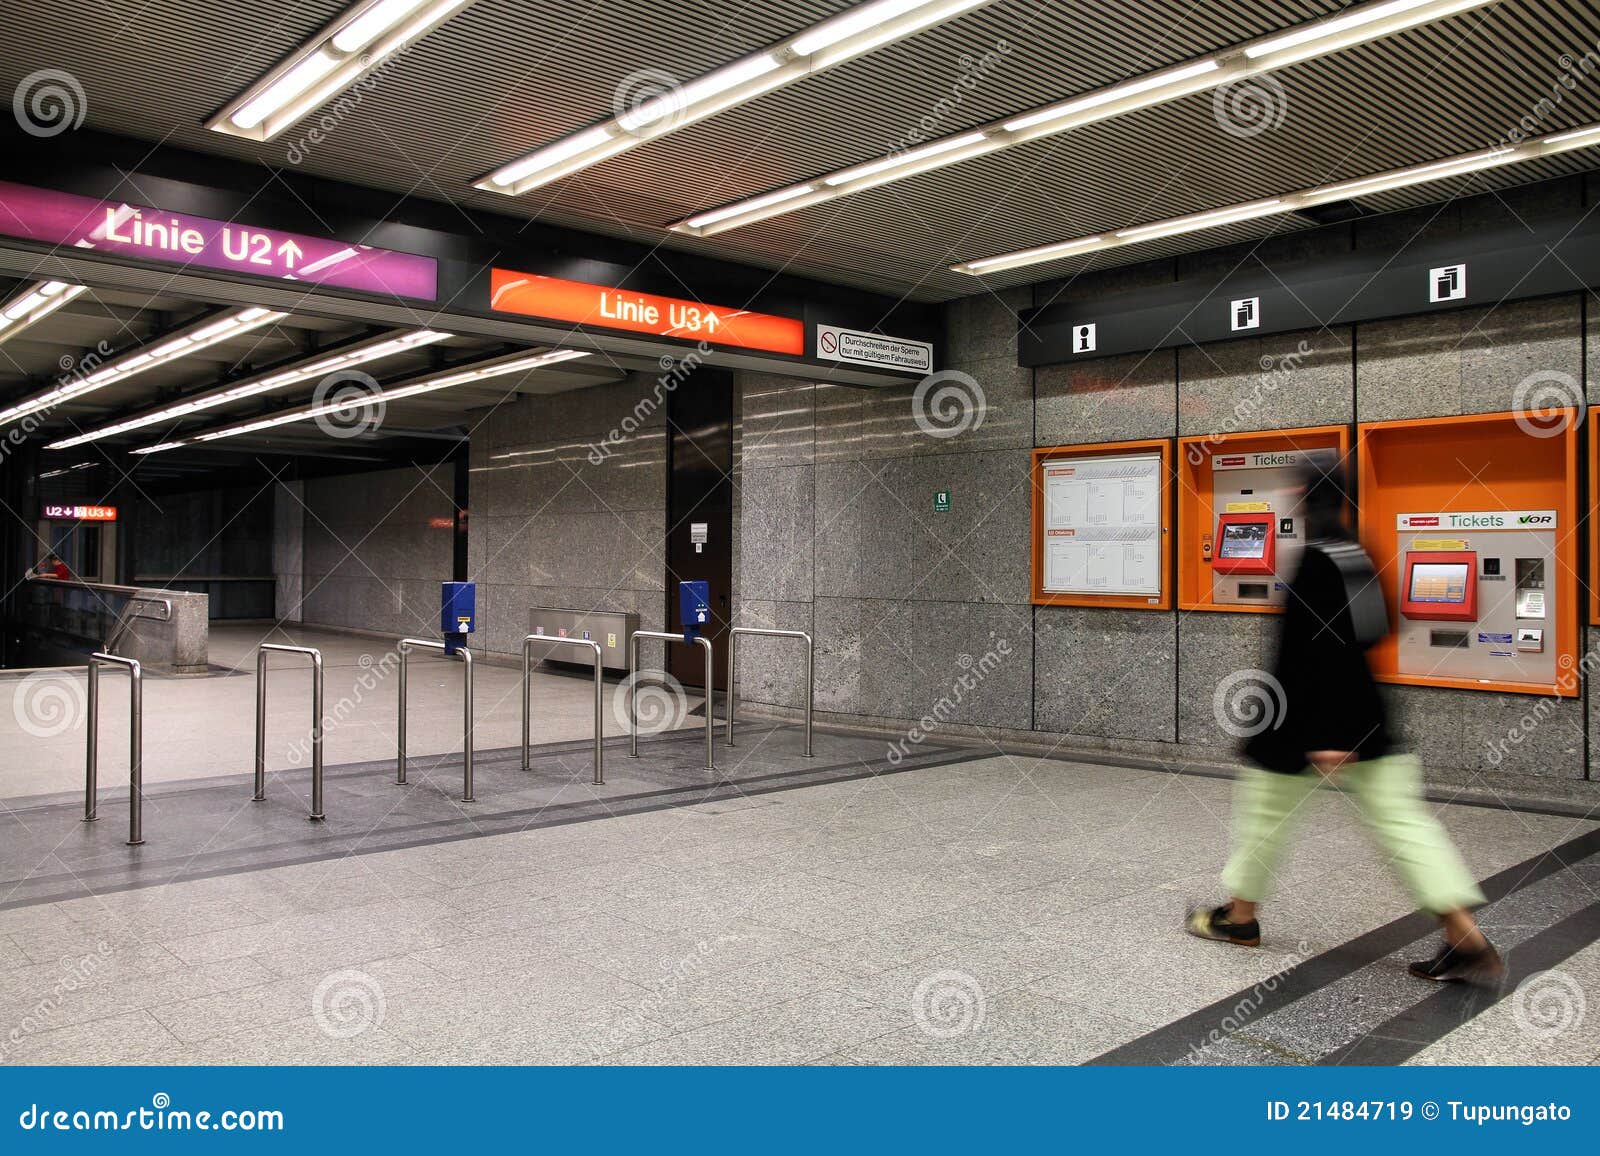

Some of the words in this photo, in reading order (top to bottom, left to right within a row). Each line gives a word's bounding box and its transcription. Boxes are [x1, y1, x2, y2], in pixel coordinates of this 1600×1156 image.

[106, 206, 205, 254] Linie
[222, 227, 273, 266] U2
[600, 291, 659, 325] Linie
[669, 303, 702, 332] U3
[845, 337, 889, 350] Durchschreiten
[901, 346, 919, 355] Sperre
[853, 348, 863, 356] mit
[891, 353, 926, 366] Fahrausweis
[1252, 453, 1297, 467] Tickets
[46, 506, 62, 516] U2
[88, 508, 104, 517] U3
[1449, 514, 1505, 528] Tickets
[1517, 514, 1553, 526] VOR
